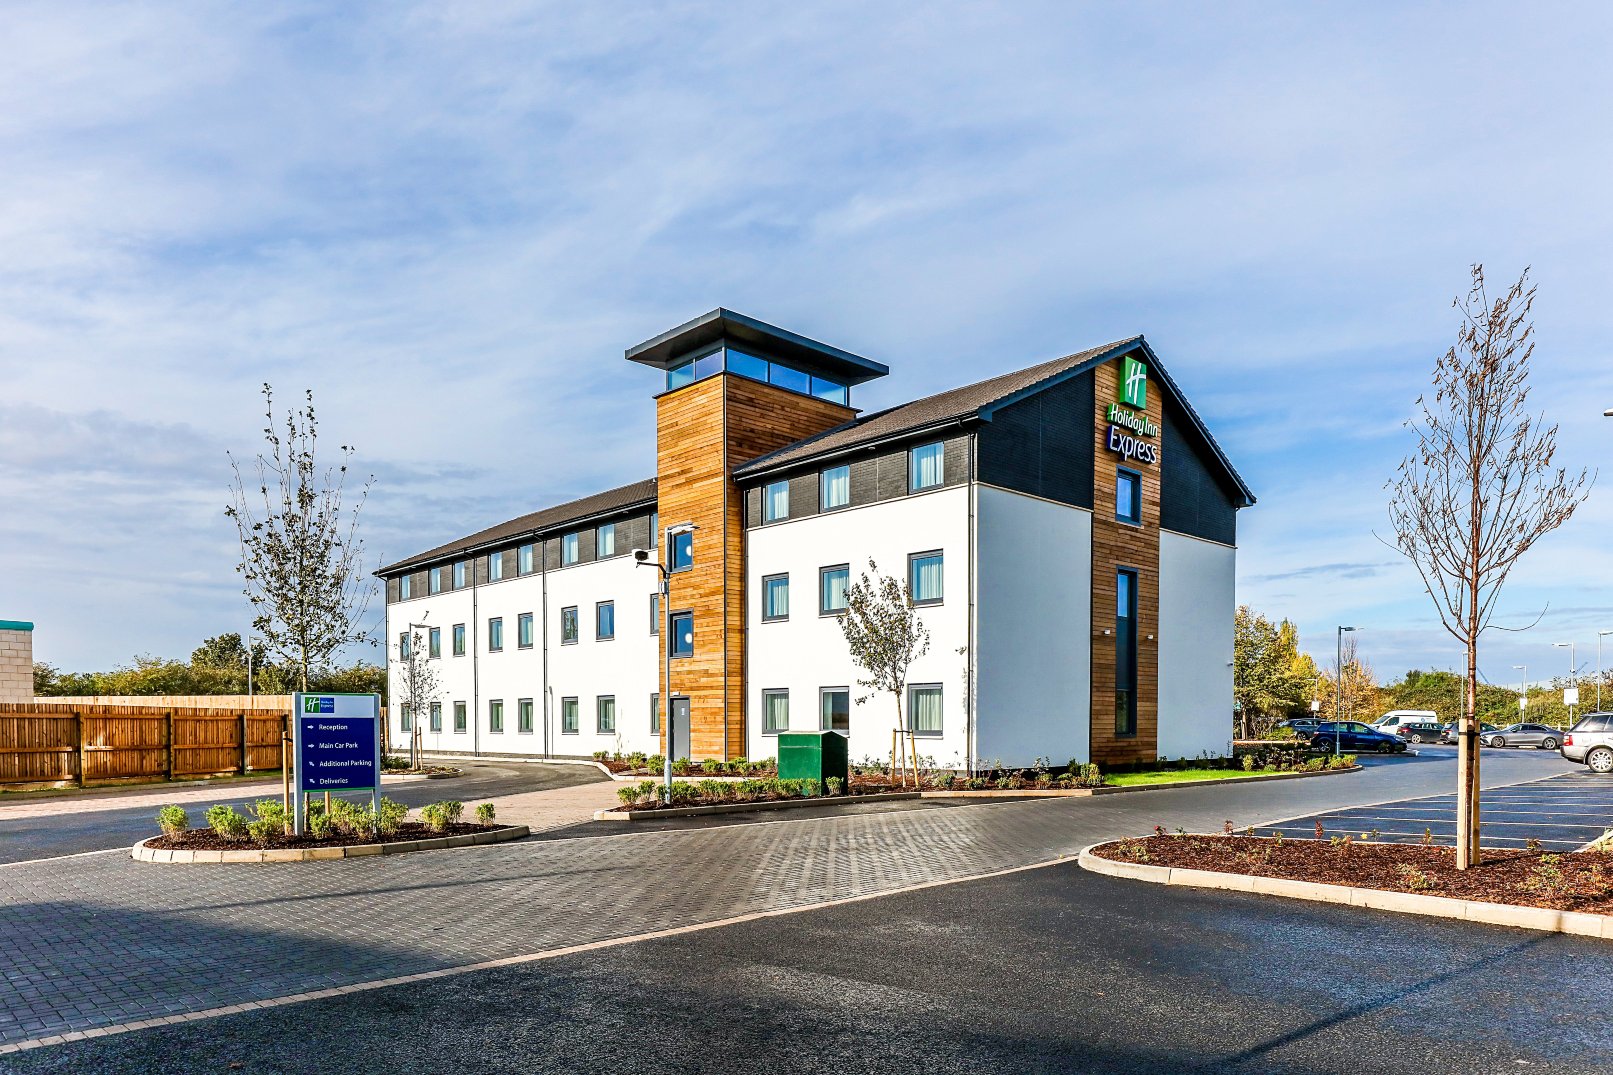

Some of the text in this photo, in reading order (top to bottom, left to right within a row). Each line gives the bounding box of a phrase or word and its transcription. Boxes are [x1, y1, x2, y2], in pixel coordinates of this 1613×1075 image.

[1109, 403, 1158, 438] Holiday Inn
[1109, 425, 1158, 464] Express
